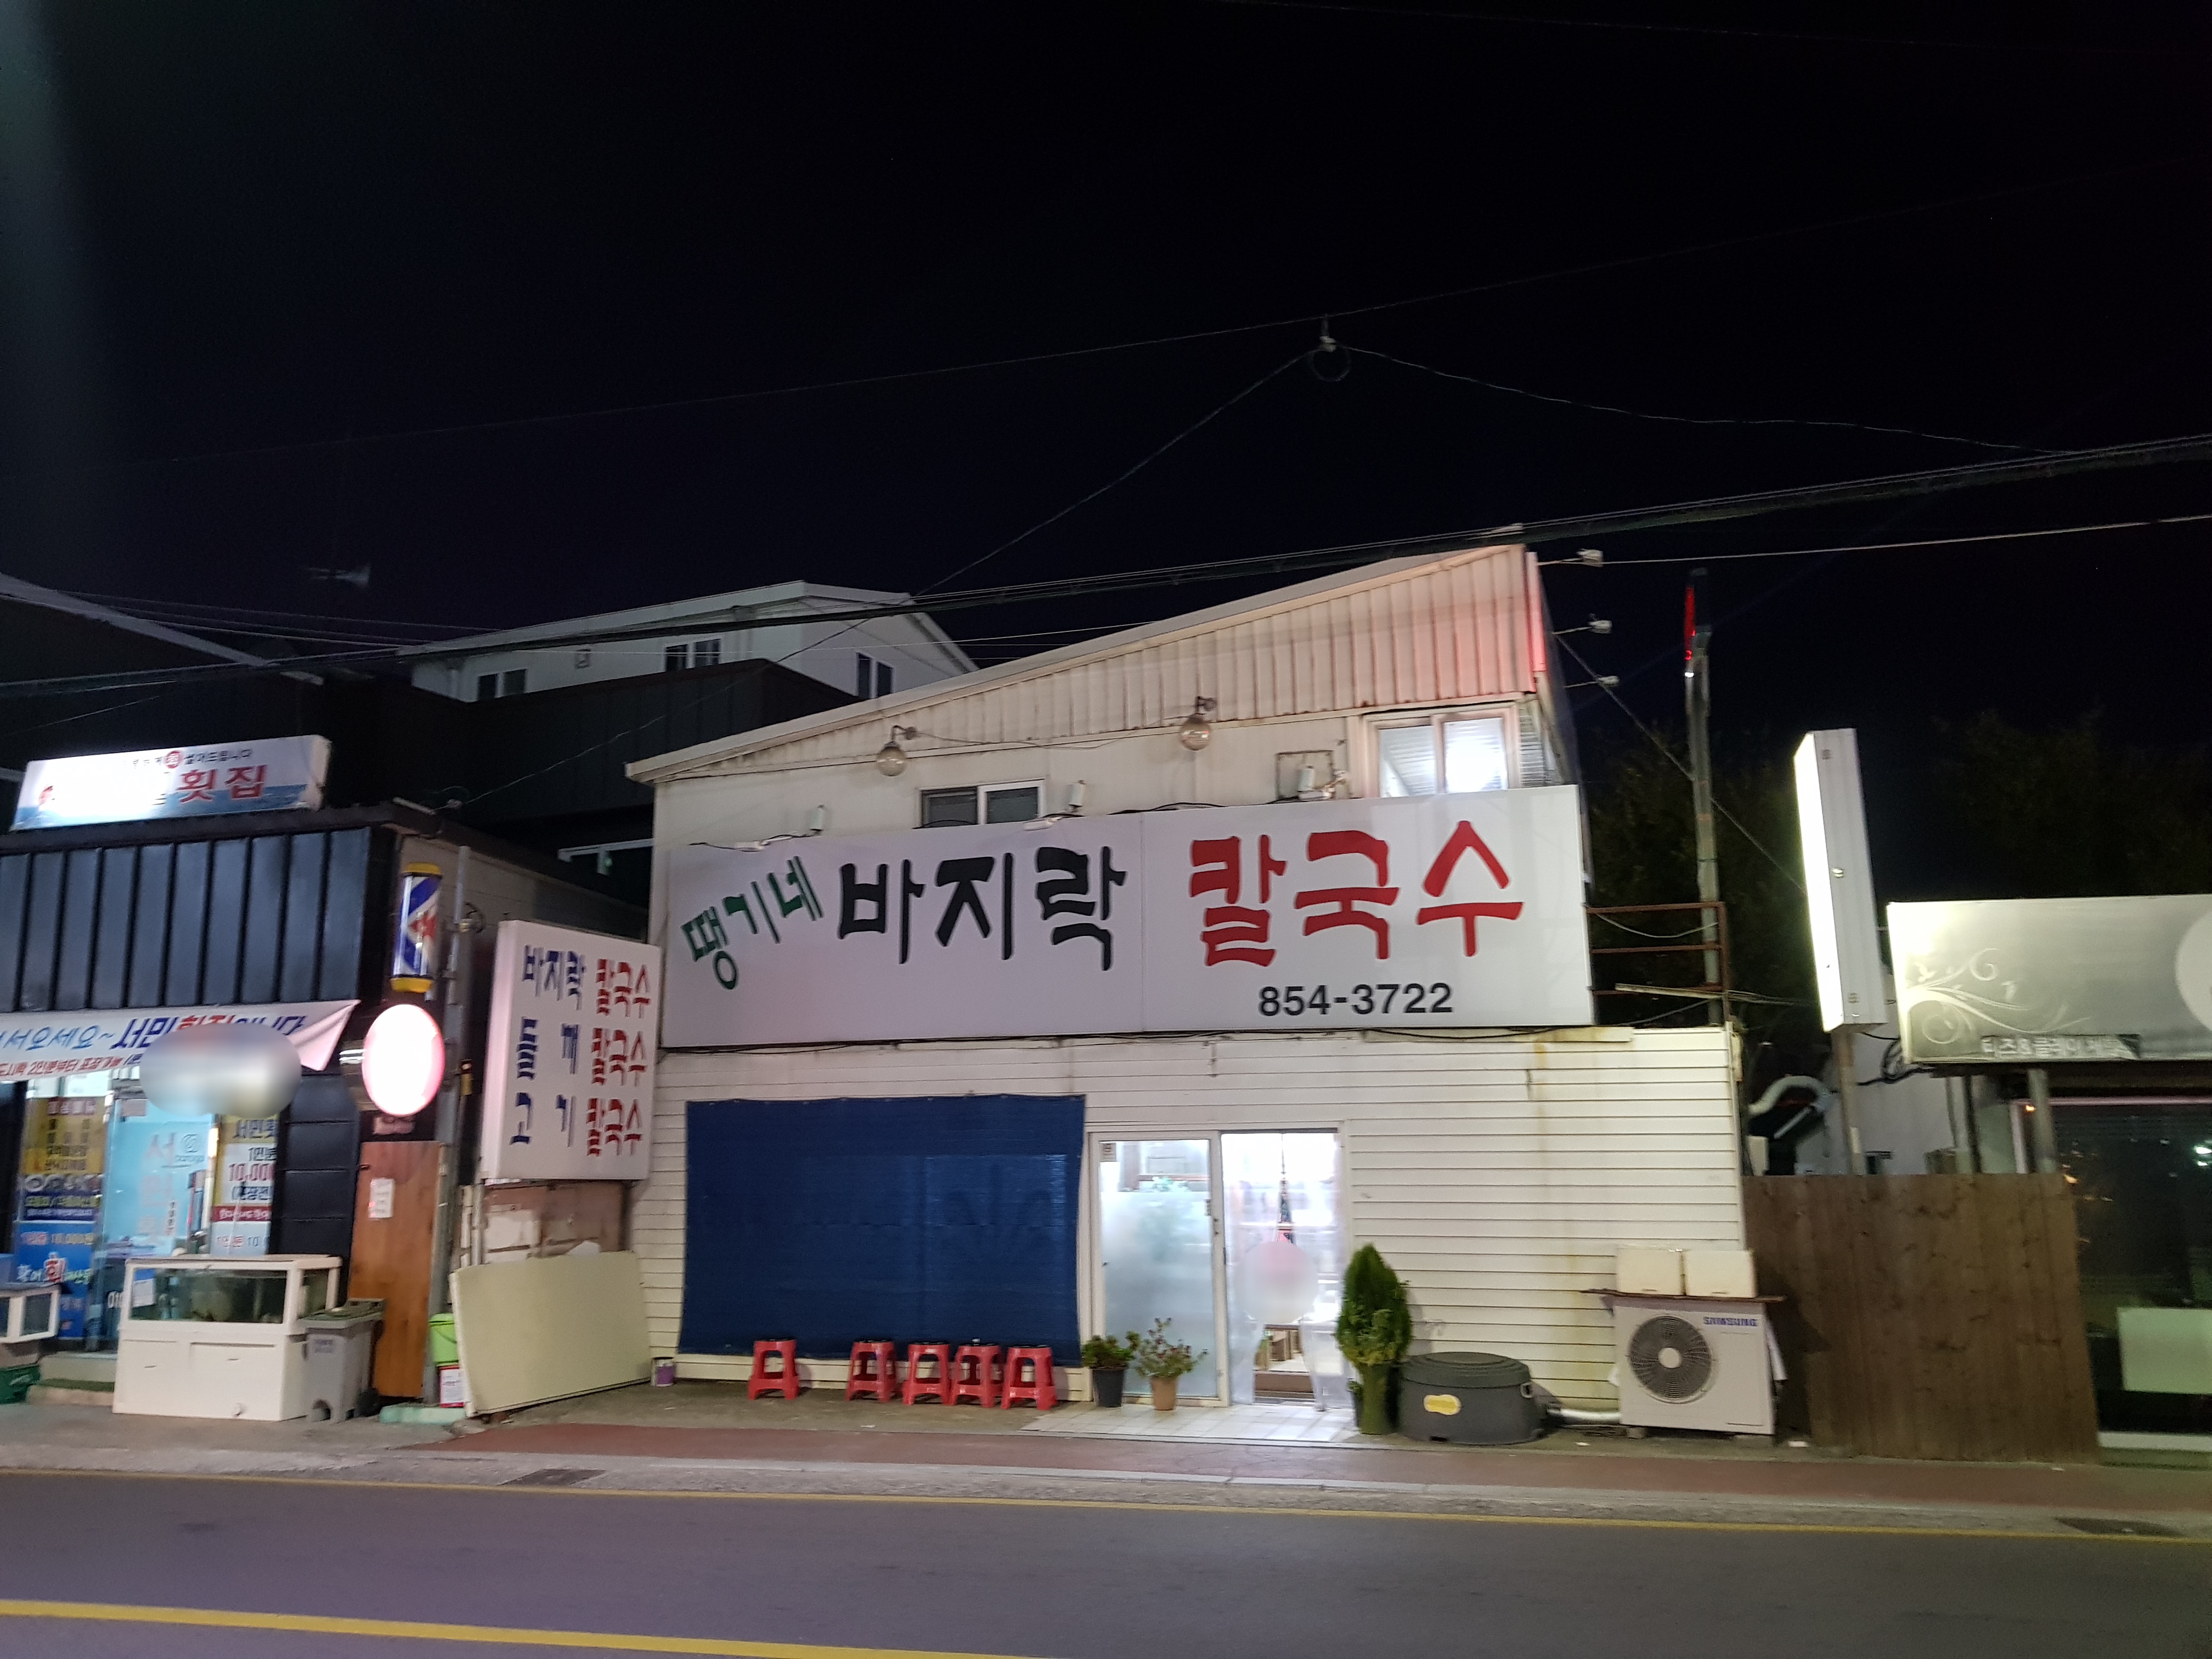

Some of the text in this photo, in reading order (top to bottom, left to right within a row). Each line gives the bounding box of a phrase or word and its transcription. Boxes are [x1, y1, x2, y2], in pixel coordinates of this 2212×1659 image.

[176, 764, 267, 803] 횟집
[680, 820, 1523, 990] 땡기네 바지락 칼국수
[523, 945, 651, 1018] 바지락 칼국수
[1259, 983, 1453, 1017] 854-3722
[591, 1028, 647, 1086] 칼국수
[586, 1098, 643, 1156] 칼국수
